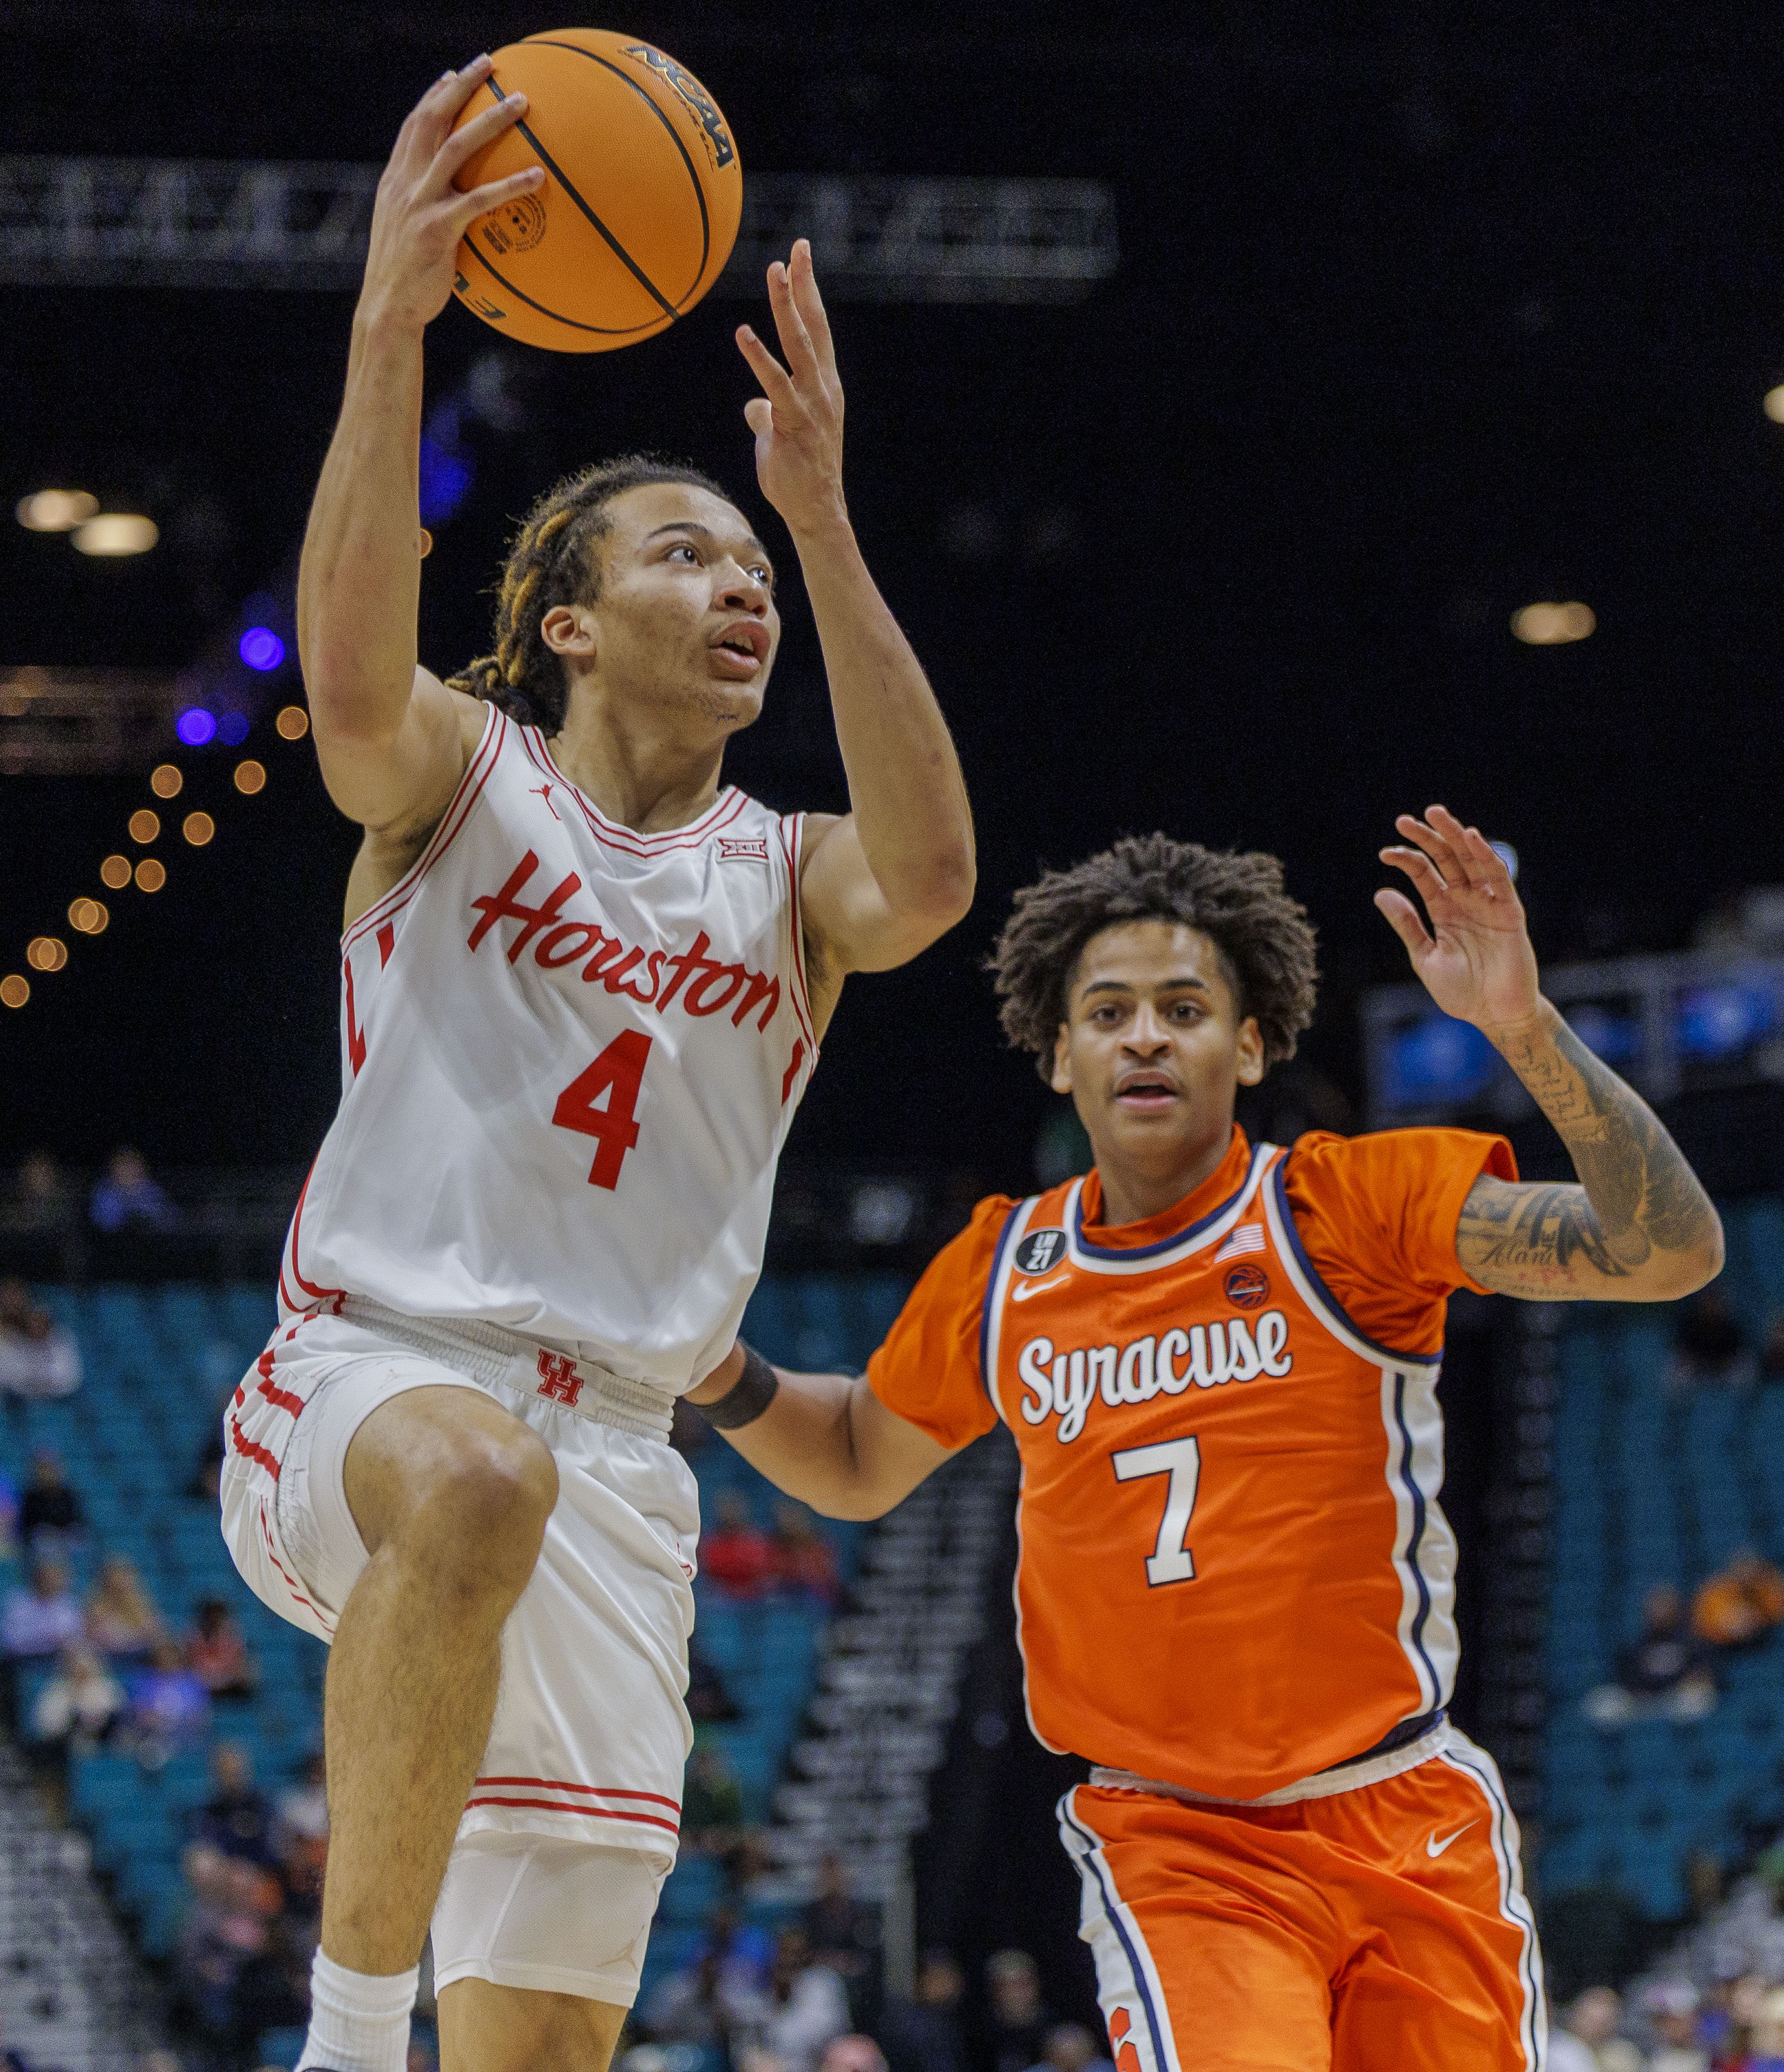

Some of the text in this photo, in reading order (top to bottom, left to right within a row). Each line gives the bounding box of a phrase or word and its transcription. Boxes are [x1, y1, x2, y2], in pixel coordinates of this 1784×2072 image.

[621, 45, 735, 170] NCAA
[467, 849, 781, 1033] Houston
[551, 1028, 653, 1191] 4
[1018, 1310, 1293, 1444] Syracuse
[1110, 1435, 1201, 1588] 7
